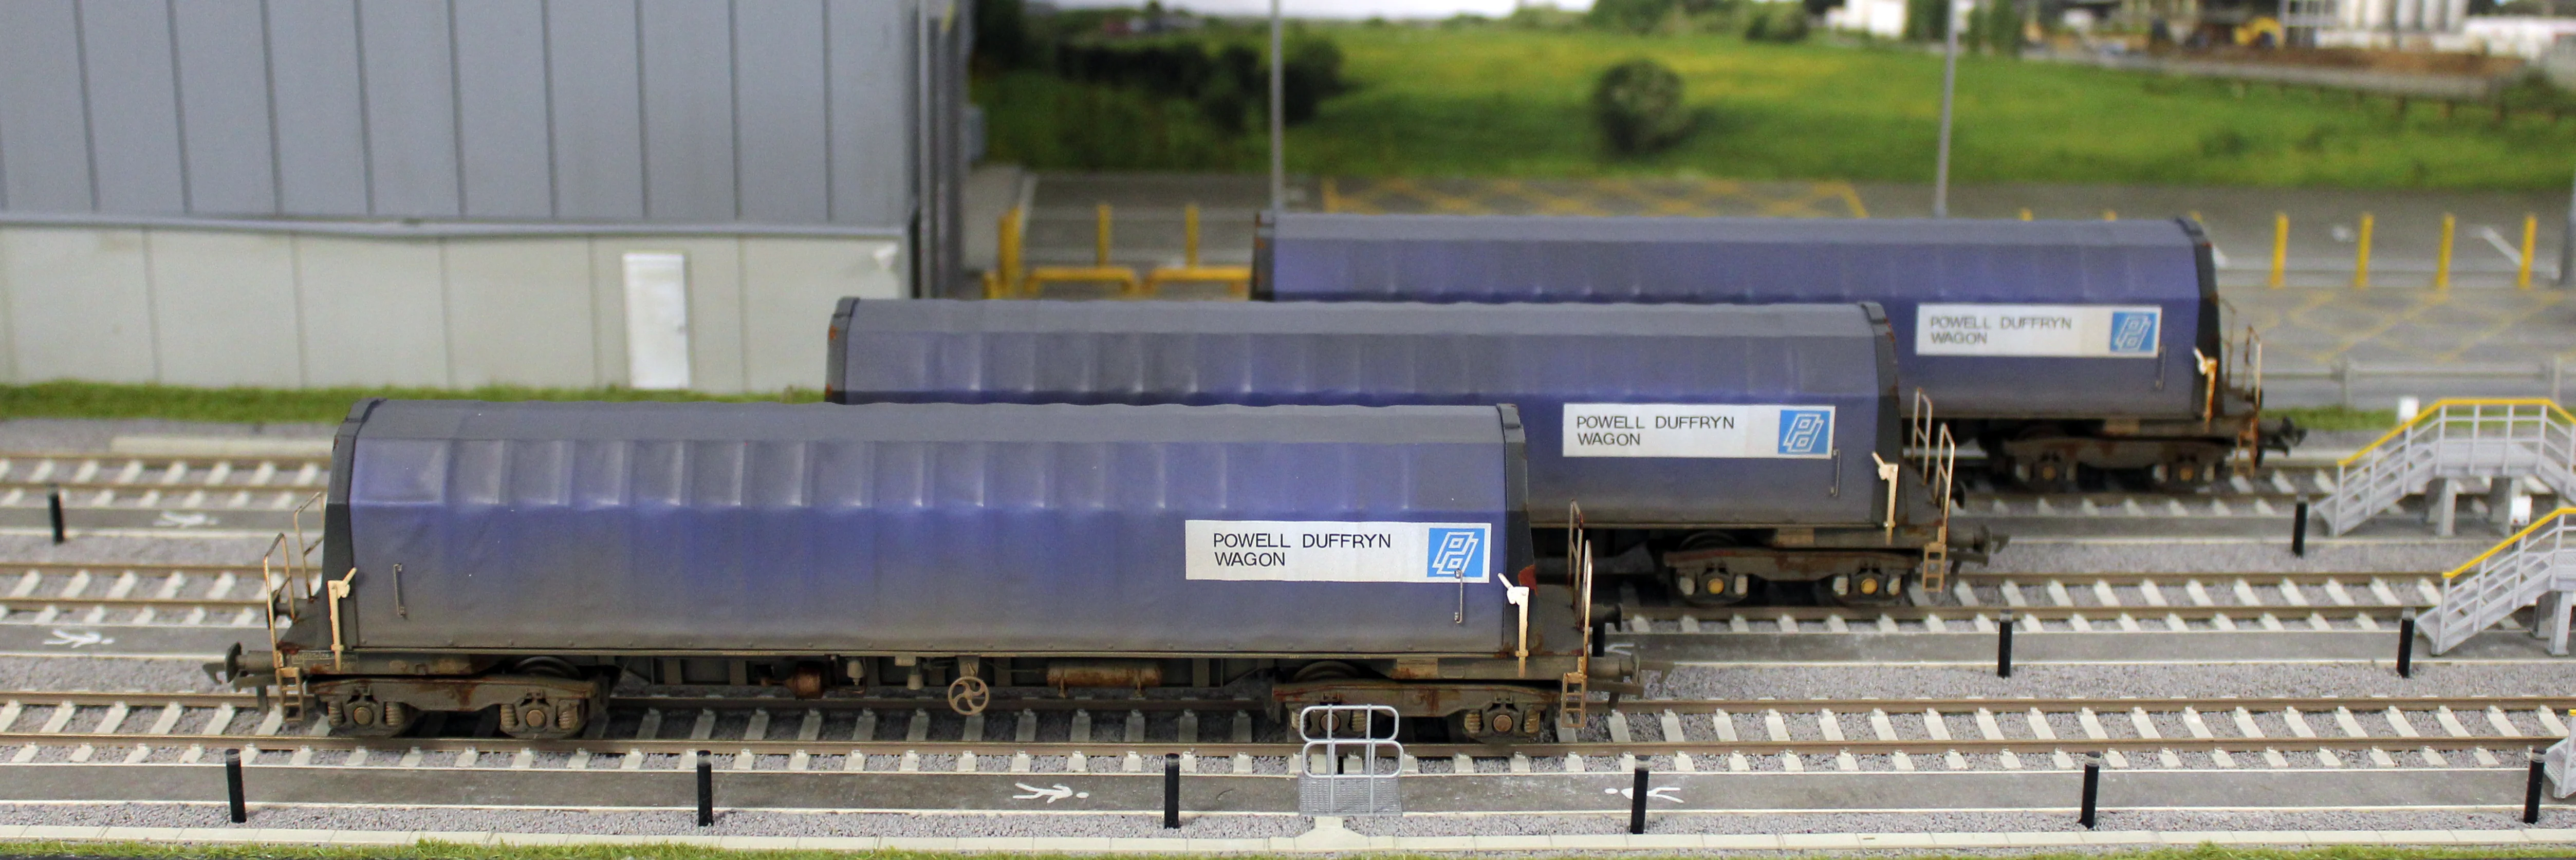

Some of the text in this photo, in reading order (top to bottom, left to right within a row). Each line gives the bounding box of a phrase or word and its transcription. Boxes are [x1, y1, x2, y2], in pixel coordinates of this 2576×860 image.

[1930, 316, 2072, 329] POWELL DUFFRYN
[1931, 331, 1987, 344] WAGON
[1577, 416, 1734, 429] POWELL DUFFRYN
[1578, 433, 1640, 446] WAGON
[1214, 533, 1391, 548] POWELL DUFFRYN
[1214, 552, 1285, 567] WAGON
